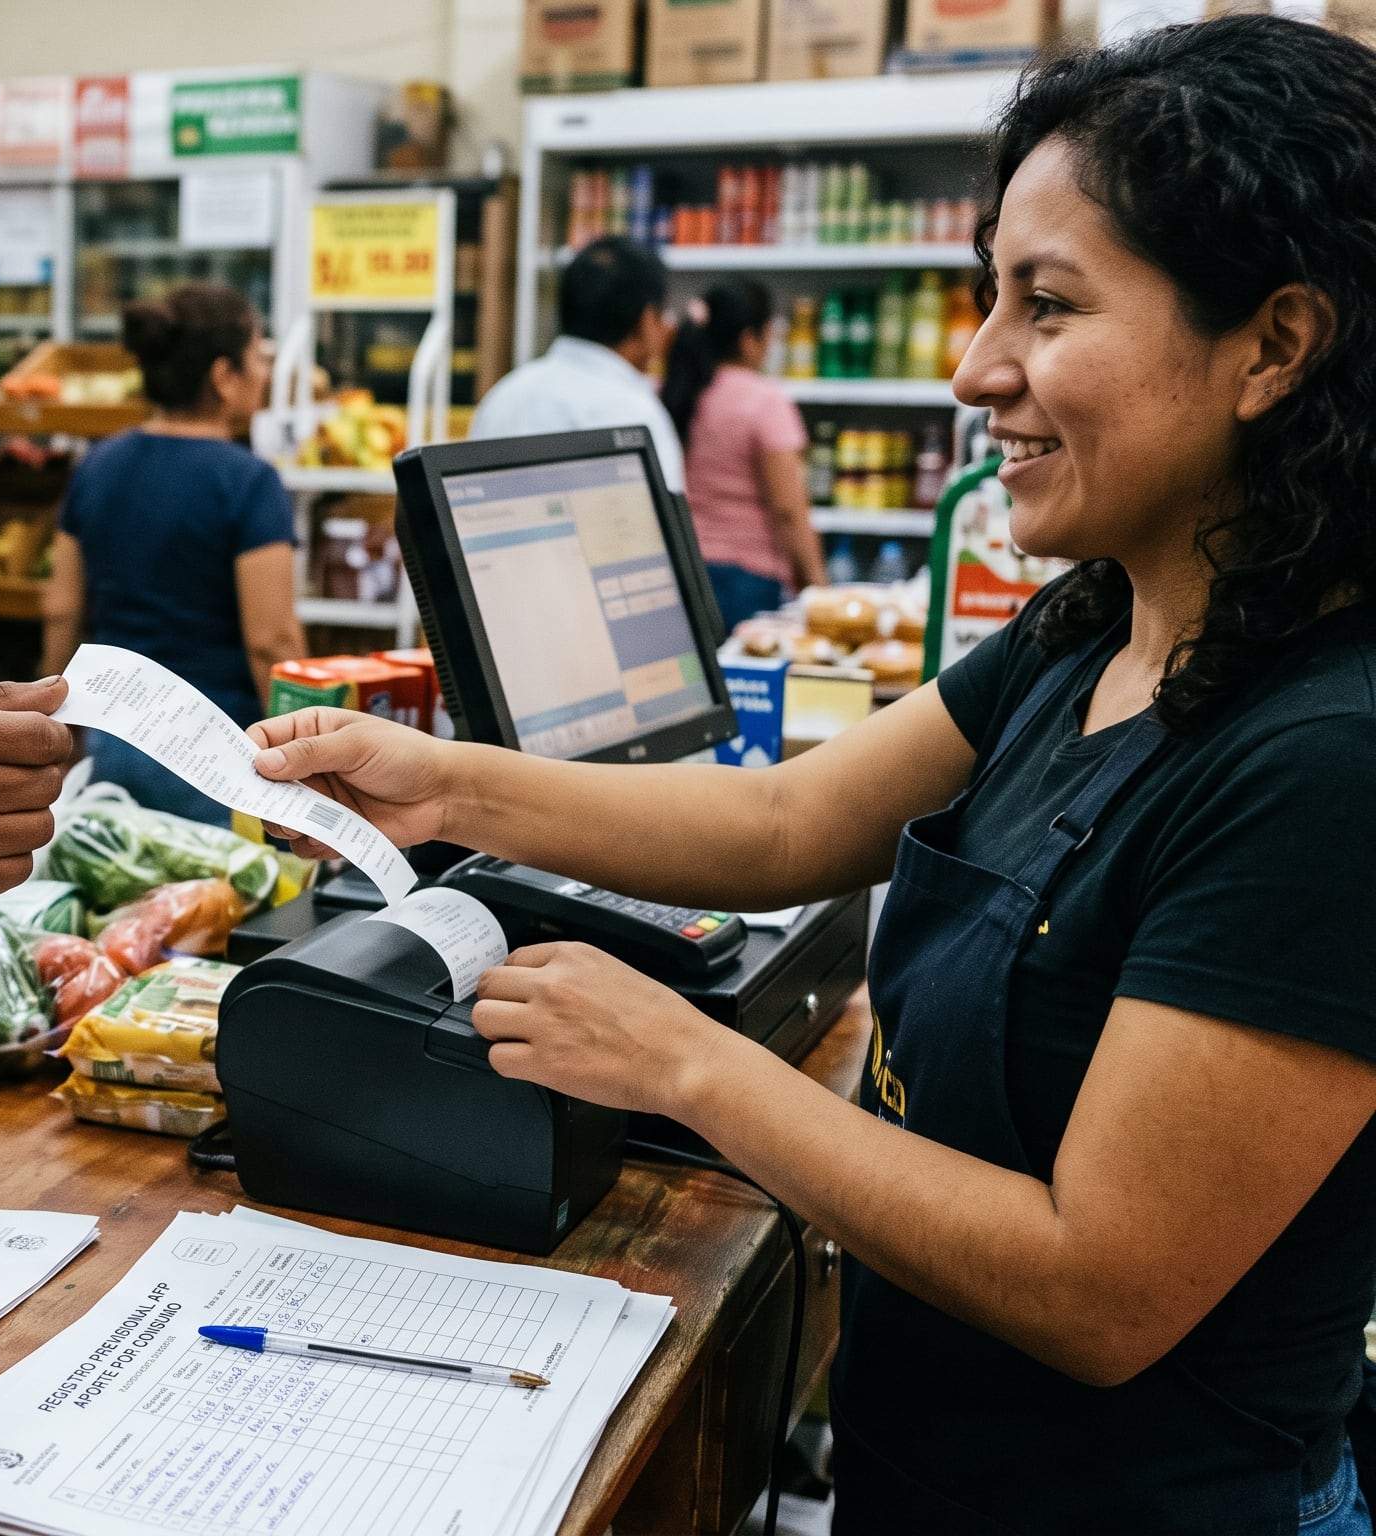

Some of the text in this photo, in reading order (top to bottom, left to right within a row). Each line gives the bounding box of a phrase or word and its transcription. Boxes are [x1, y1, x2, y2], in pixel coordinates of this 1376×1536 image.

[38, 1362, 96, 1412] REGISTRO
[89, 1304, 156, 1362] PREVISIONAL
[148, 1282, 170, 1302] AFP
[73, 1369, 119, 1409] APORTE
[111, 1348, 140, 1369] POR
[132, 1302, 182, 1348] CONSUMO
